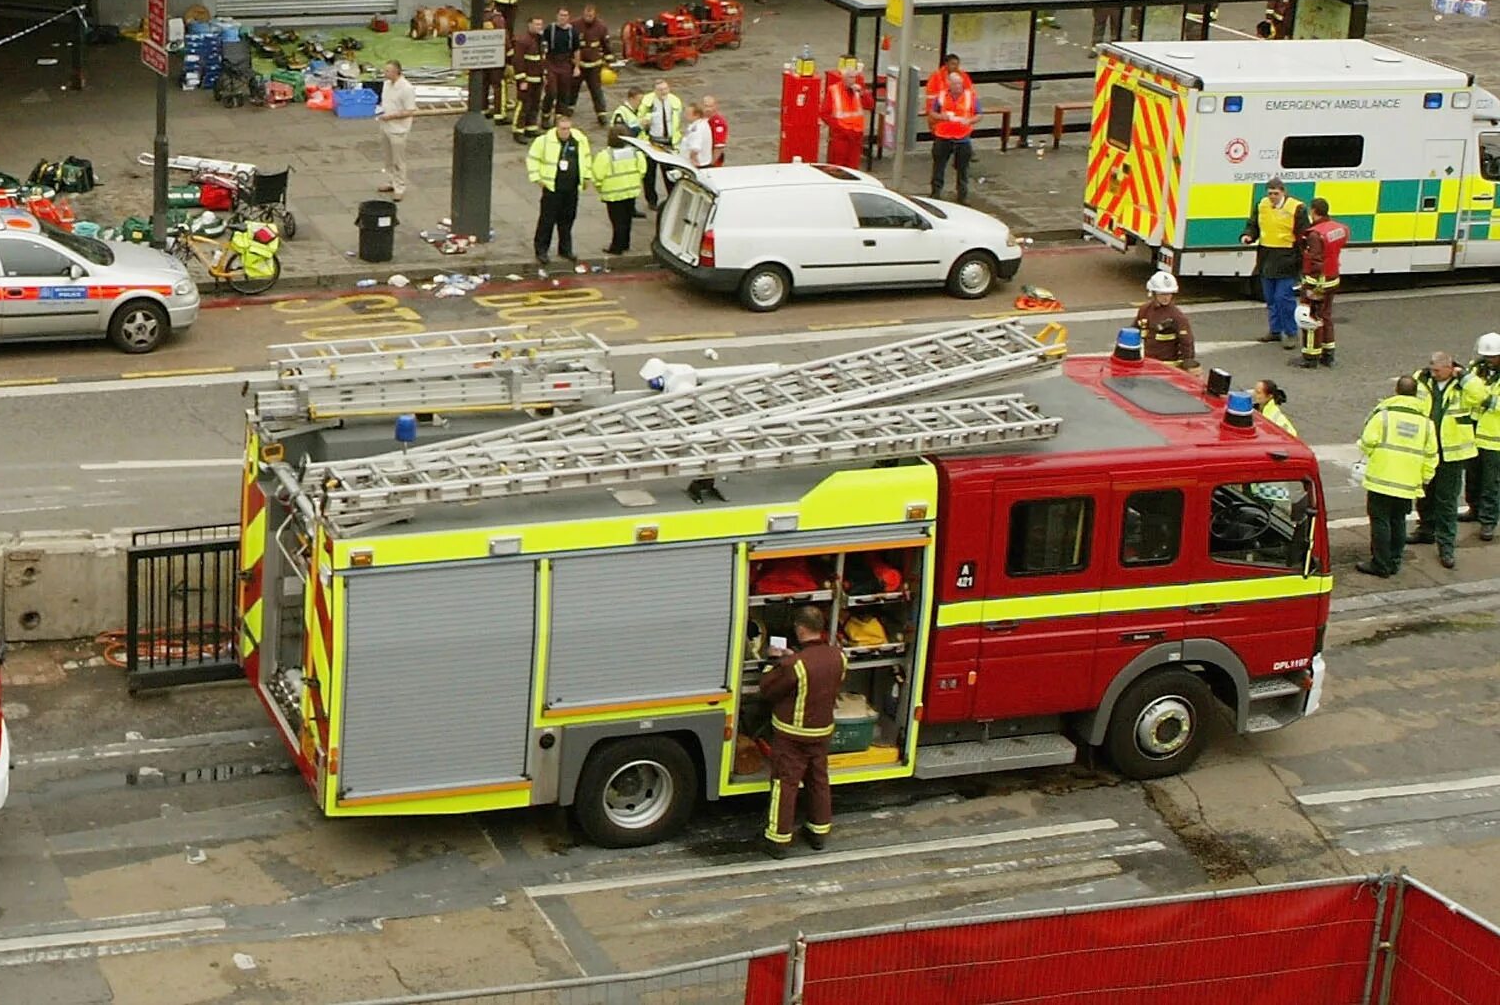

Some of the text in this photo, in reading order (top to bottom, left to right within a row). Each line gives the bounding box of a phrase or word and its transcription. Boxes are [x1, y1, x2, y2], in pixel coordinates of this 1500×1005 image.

[1265, 98, 1401, 111] EMERGENCY AMBULANCE
[1234, 169, 1377, 182] SURREY AMBULANCE SERVICE
[961, 564, 970, 575] A
